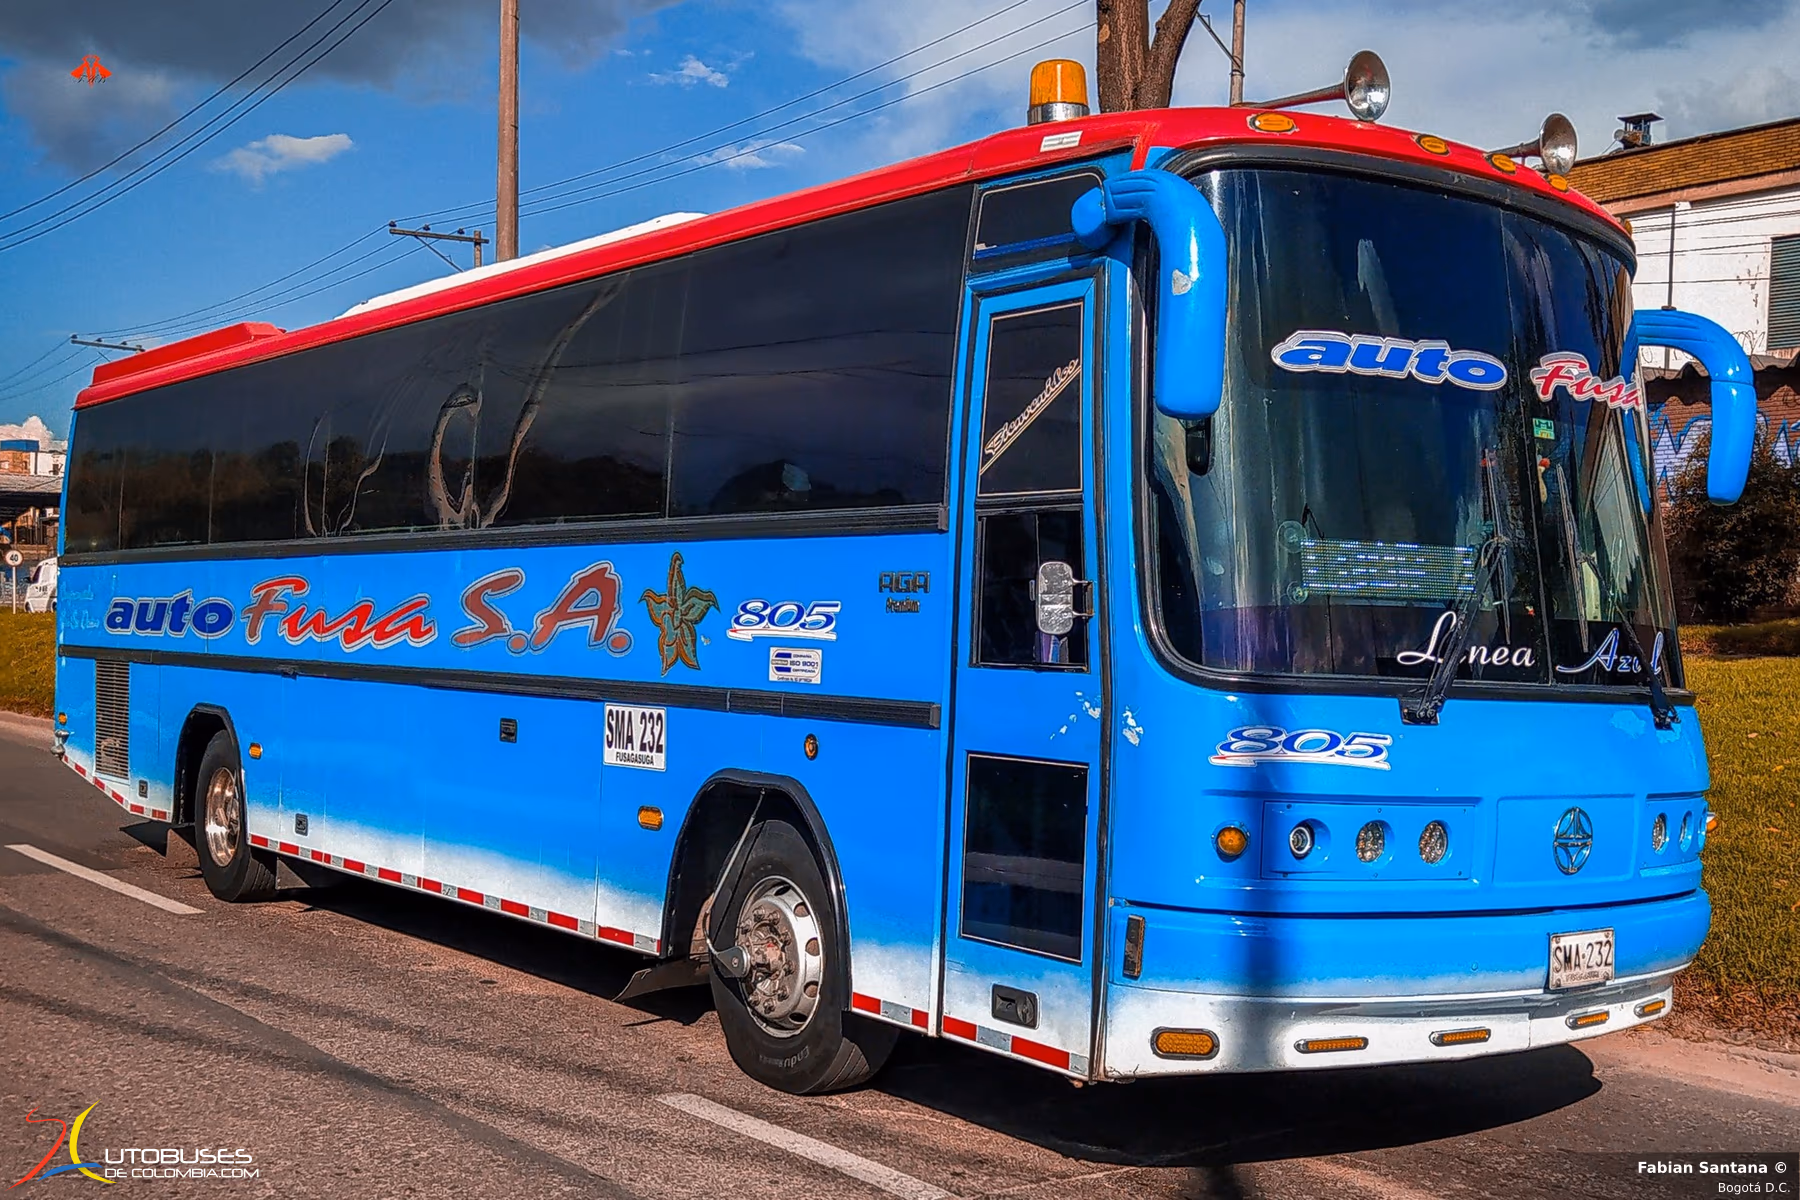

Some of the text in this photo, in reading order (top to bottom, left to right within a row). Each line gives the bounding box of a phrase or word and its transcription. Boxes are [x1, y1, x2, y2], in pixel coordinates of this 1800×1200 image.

[1272, 331, 1643, 410] auto Fusa
[10, 553, 18, 563] 40
[879, 571, 930, 593] AGA
[105, 560, 632, 656] auto Fusa S.A.
[731, 600, 841, 634] 805
[1397, 611, 1535, 667] Lnea
[606, 708, 663, 754] SMA 232
[1214, 727, 1391, 762] 805
[615, 751, 655, 766] FUSAGASUGA
